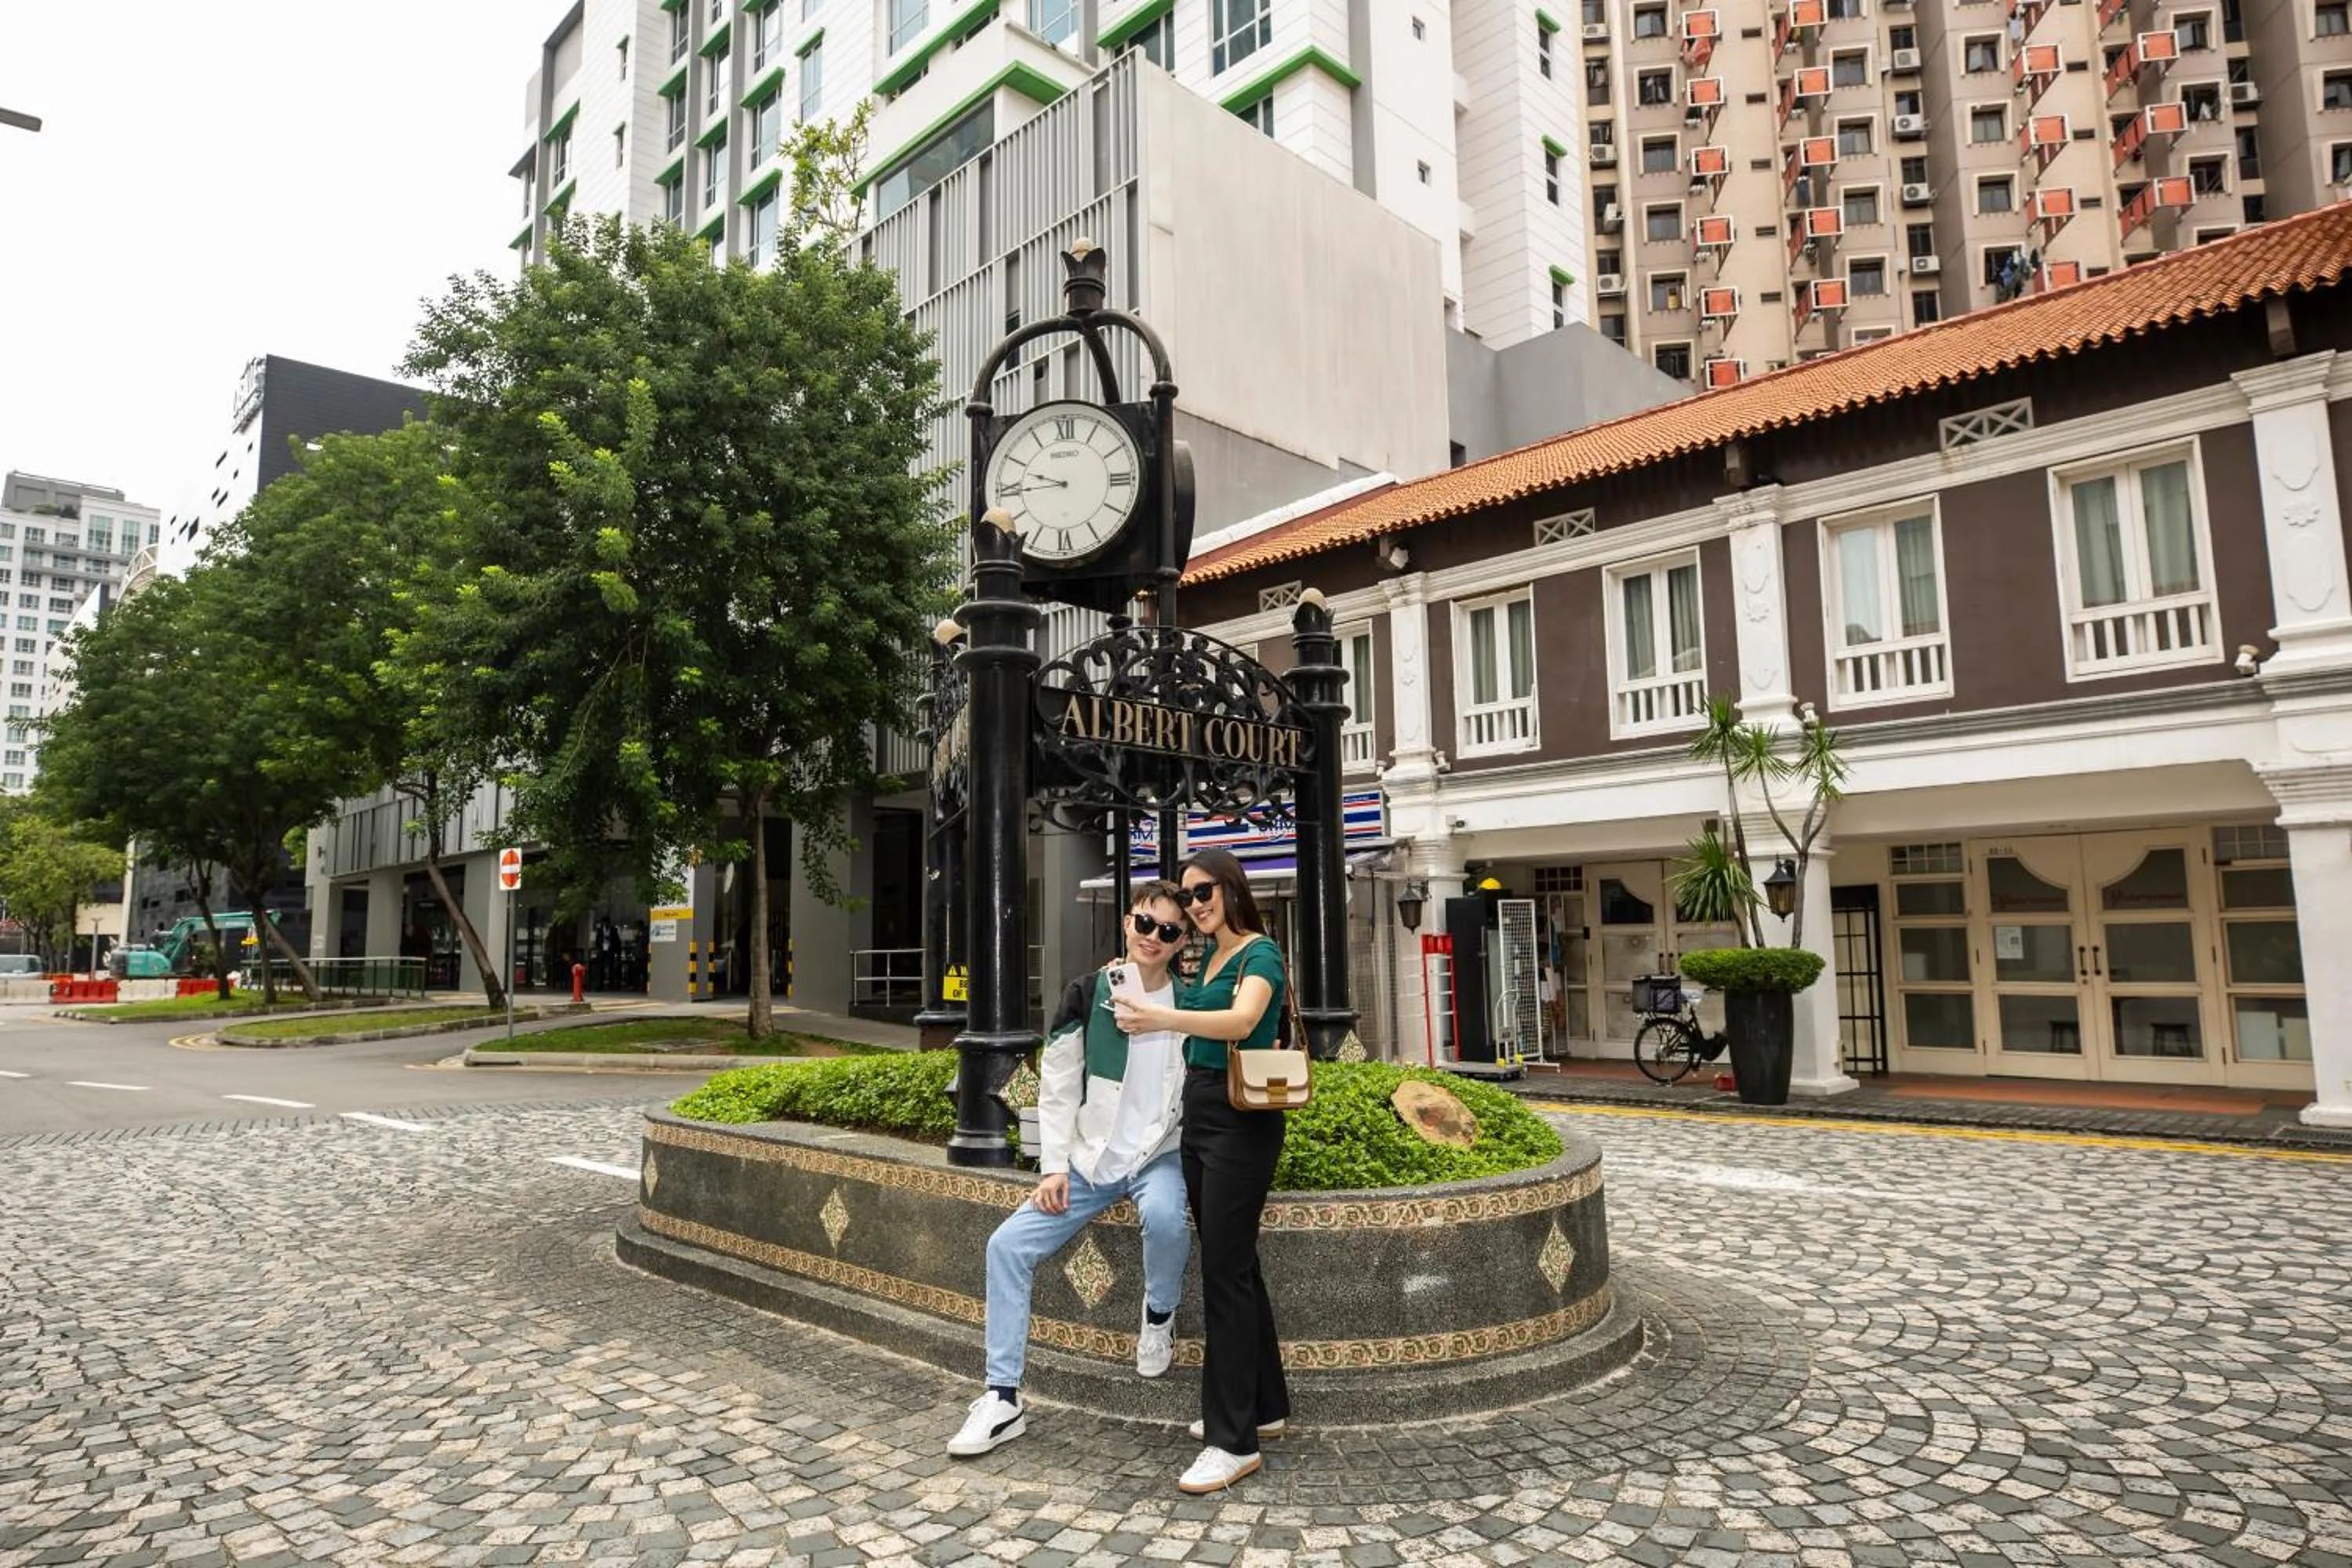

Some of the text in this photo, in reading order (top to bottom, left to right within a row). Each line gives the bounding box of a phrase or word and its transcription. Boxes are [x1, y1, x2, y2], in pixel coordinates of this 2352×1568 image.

[1054, 419, 1075, 440] XII
[1110, 472, 1131, 487] III
[1061, 694, 1301, 768] ALBERT COURT
